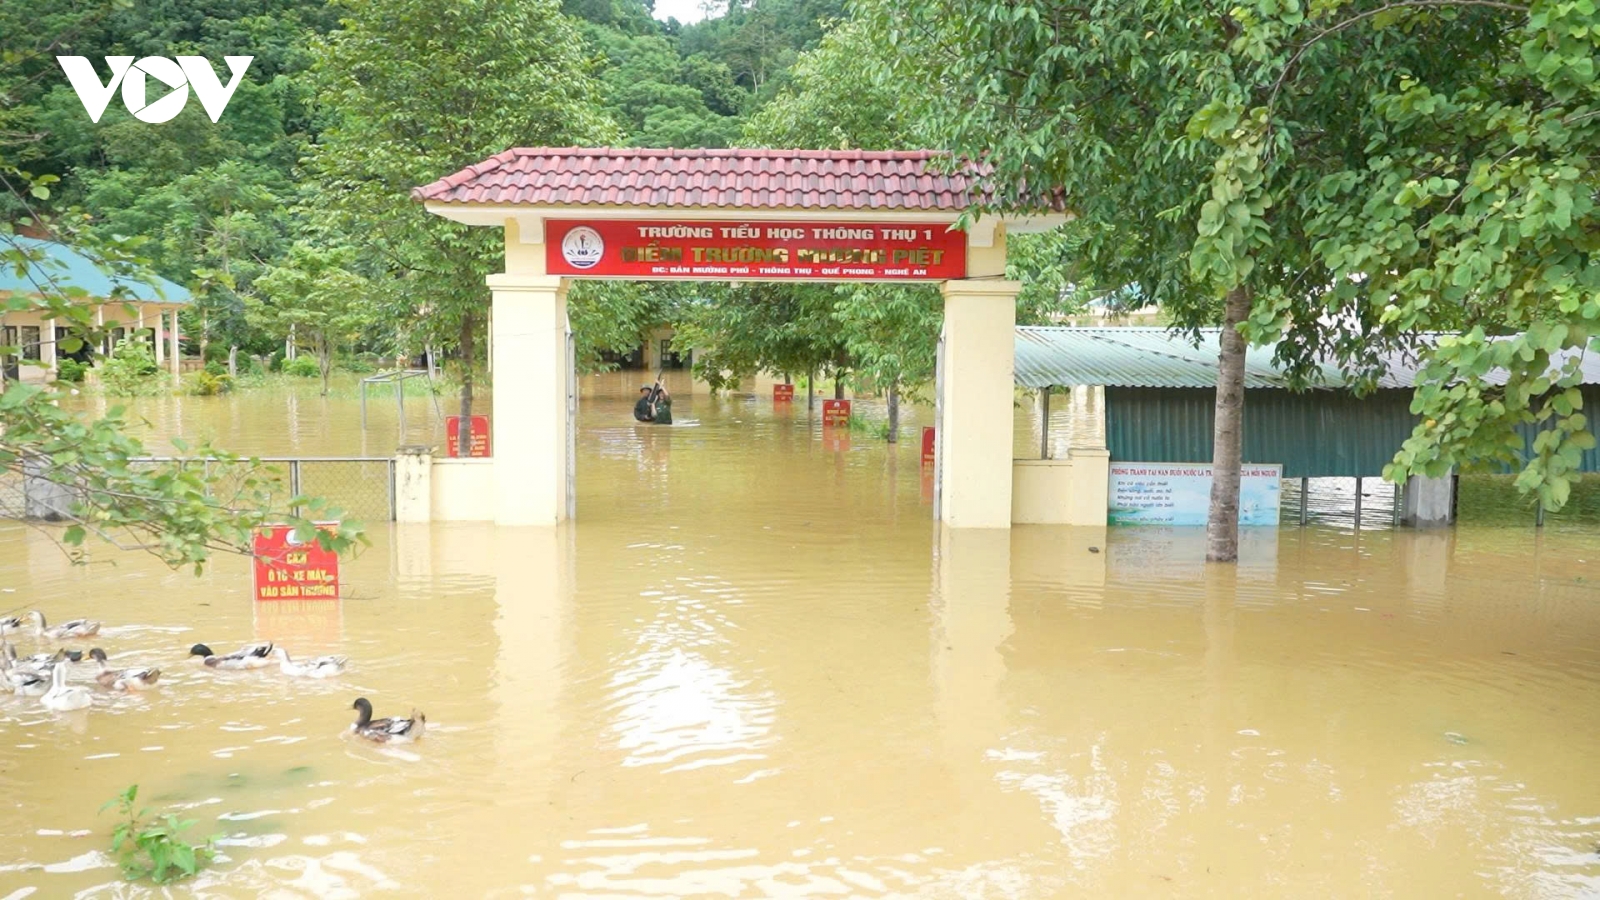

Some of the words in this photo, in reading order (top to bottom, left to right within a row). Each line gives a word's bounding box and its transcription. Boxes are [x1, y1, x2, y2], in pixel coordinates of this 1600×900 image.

[637, 224, 713, 239] TRƯỜNG
[720, 223, 760, 239] TIỂU
[766, 227, 805, 241] HỌC
[811, 226, 874, 240] THÔNG
[880, 229, 917, 242] THỤ
[923, 229, 932, 240] 1
[621, 240, 682, 263] ĐIỂM
[691, 243, 789, 263] TRƯỜNG
[893, 245, 945, 267] PIỆT
[759, 266, 791, 274] THÔNG
[306, 567, 328, 581] MÁY
[260, 584, 278, 597] VÀO
[279, 583, 299, 597] SÂN
